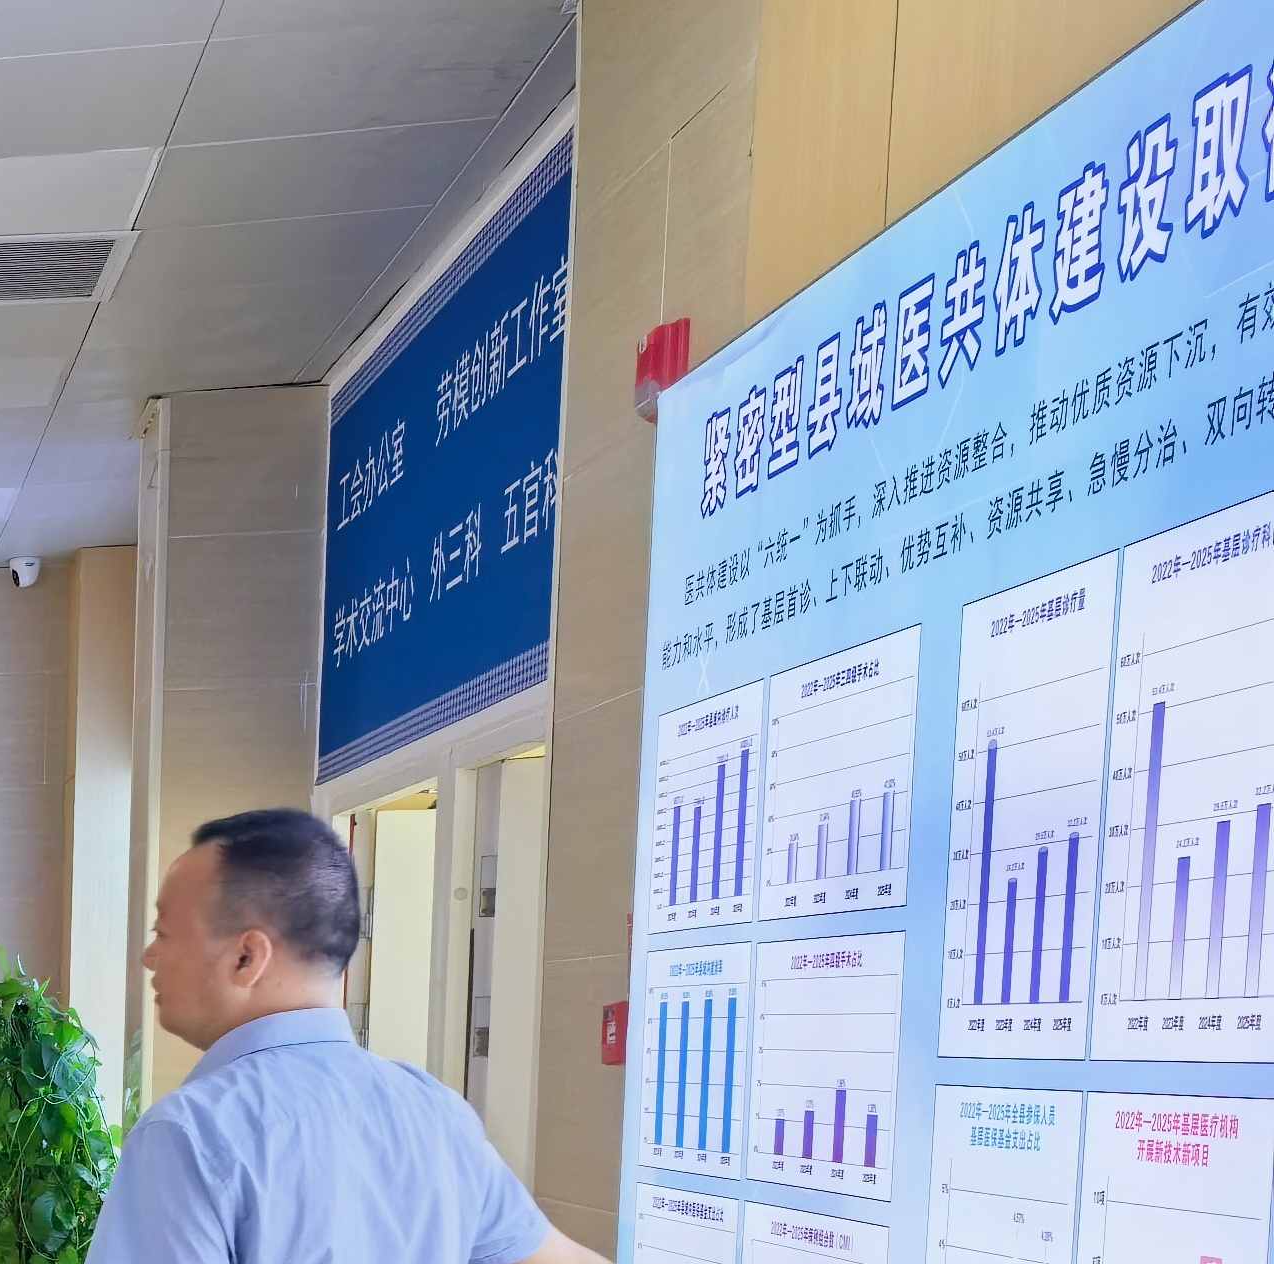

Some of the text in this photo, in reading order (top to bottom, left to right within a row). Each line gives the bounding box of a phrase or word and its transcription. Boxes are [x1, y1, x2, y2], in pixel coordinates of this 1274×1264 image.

[337, 256, 570, 532] 工会办公室 劳模创新工作室
[700, 57, 1274, 518] 紧密型县域医共体建设取
[333, 450, 562, 669] 学术交流中心 外三科 五官科
